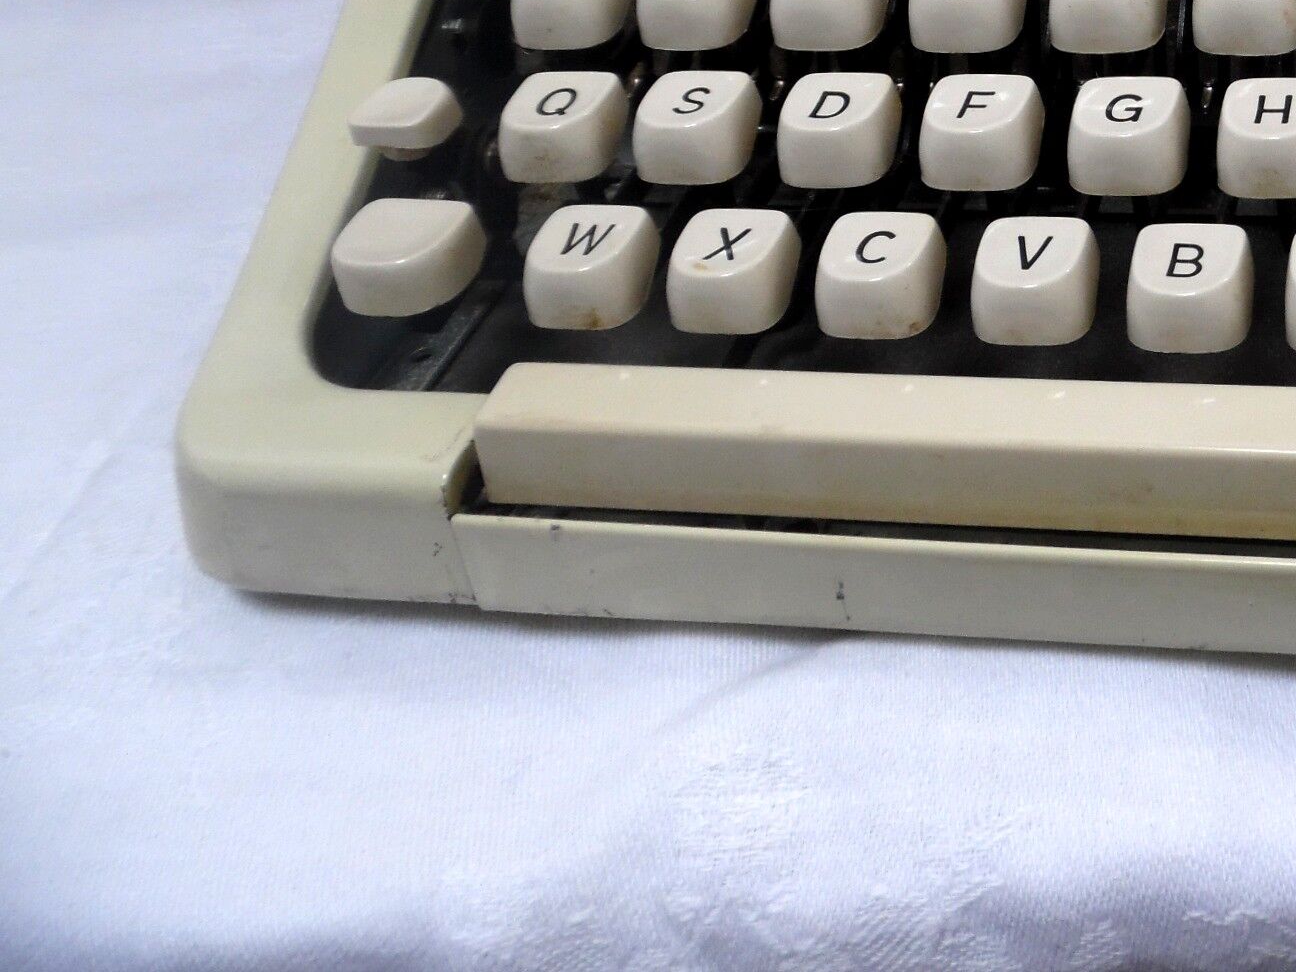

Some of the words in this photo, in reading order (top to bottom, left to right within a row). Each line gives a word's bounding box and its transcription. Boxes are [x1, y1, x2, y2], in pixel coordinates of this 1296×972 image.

[535, 87, 578, 116] Q
[672, 87, 711, 115] S
[808, 90, 851, 119] D
[956, 90, 996, 119] F
[1104, 93, 1144, 123] G
[1253, 94, 1293, 125] H
[560, 222, 616, 256] W
[702, 227, 752, 261] X
[855, 230, 897, 264] C
[1017, 235, 1054, 271] V
[1165, 242, 1205, 278] B
